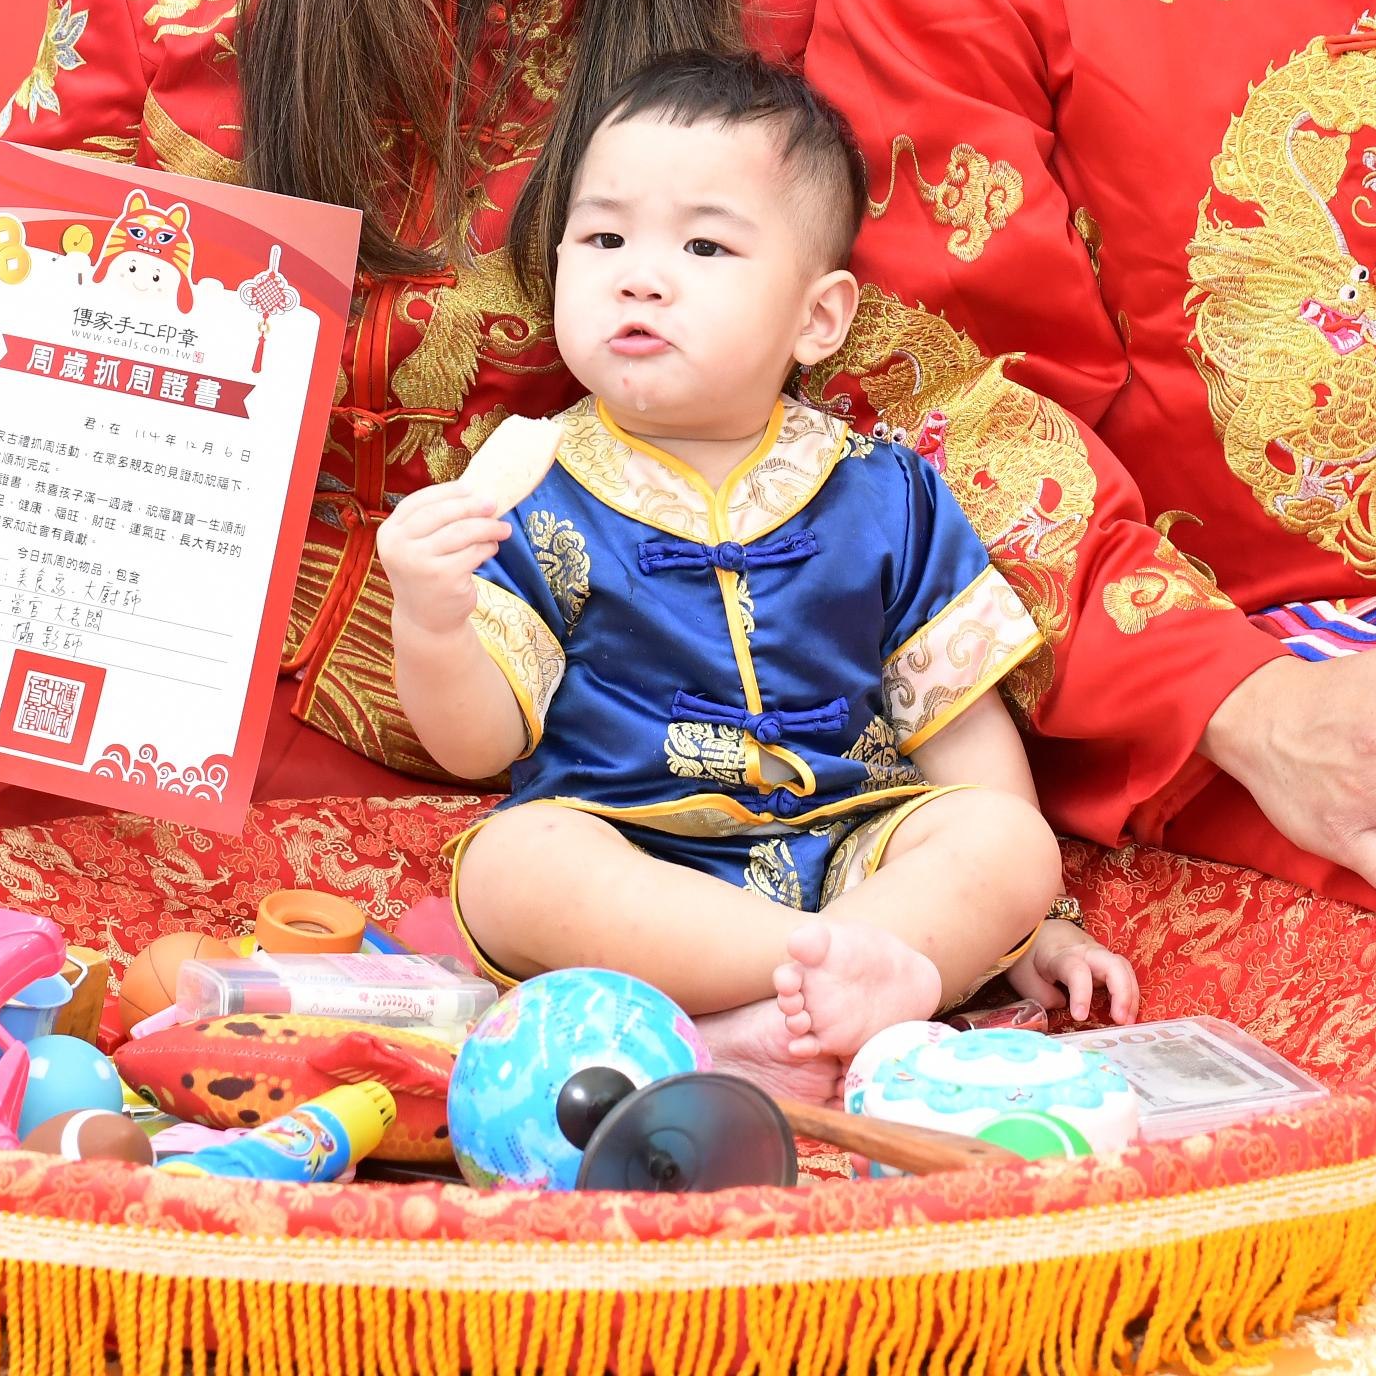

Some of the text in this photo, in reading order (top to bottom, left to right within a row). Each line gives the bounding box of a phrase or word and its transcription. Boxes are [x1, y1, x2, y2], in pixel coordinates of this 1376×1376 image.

[71, 328, 191, 359] www.seals.com.tw
[73, 307, 198, 348] 傳家手工印章
[26, 344, 222, 409] 周歲抓周證書
[202, 442, 213, 454] 月
[241, 450, 251, 462] 日
